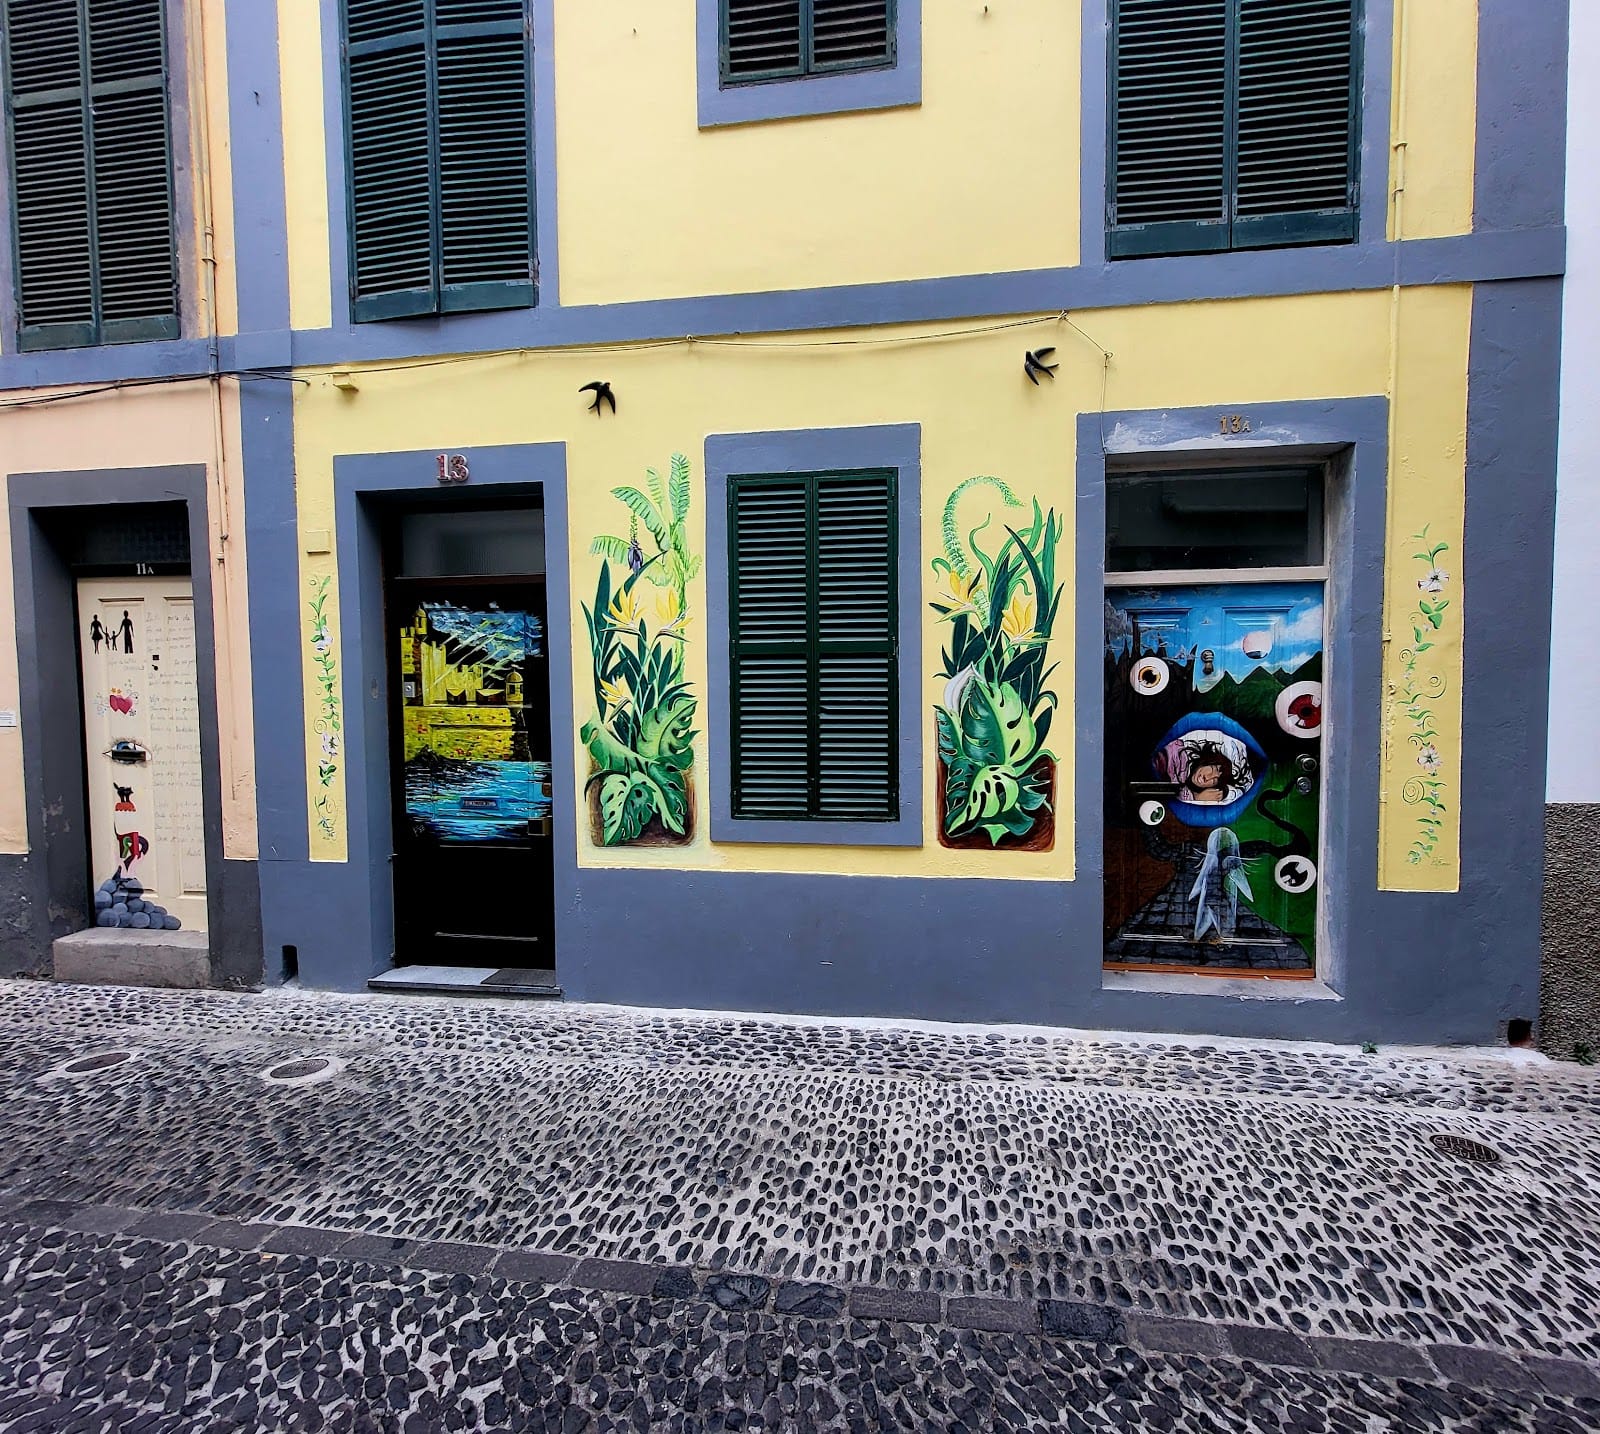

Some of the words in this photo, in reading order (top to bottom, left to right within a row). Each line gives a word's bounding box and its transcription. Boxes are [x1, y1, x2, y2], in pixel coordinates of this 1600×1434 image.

[1219, 414, 1251, 435] 13A
[435, 453, 470, 482] 13
[136, 563, 154, 575] 11A
